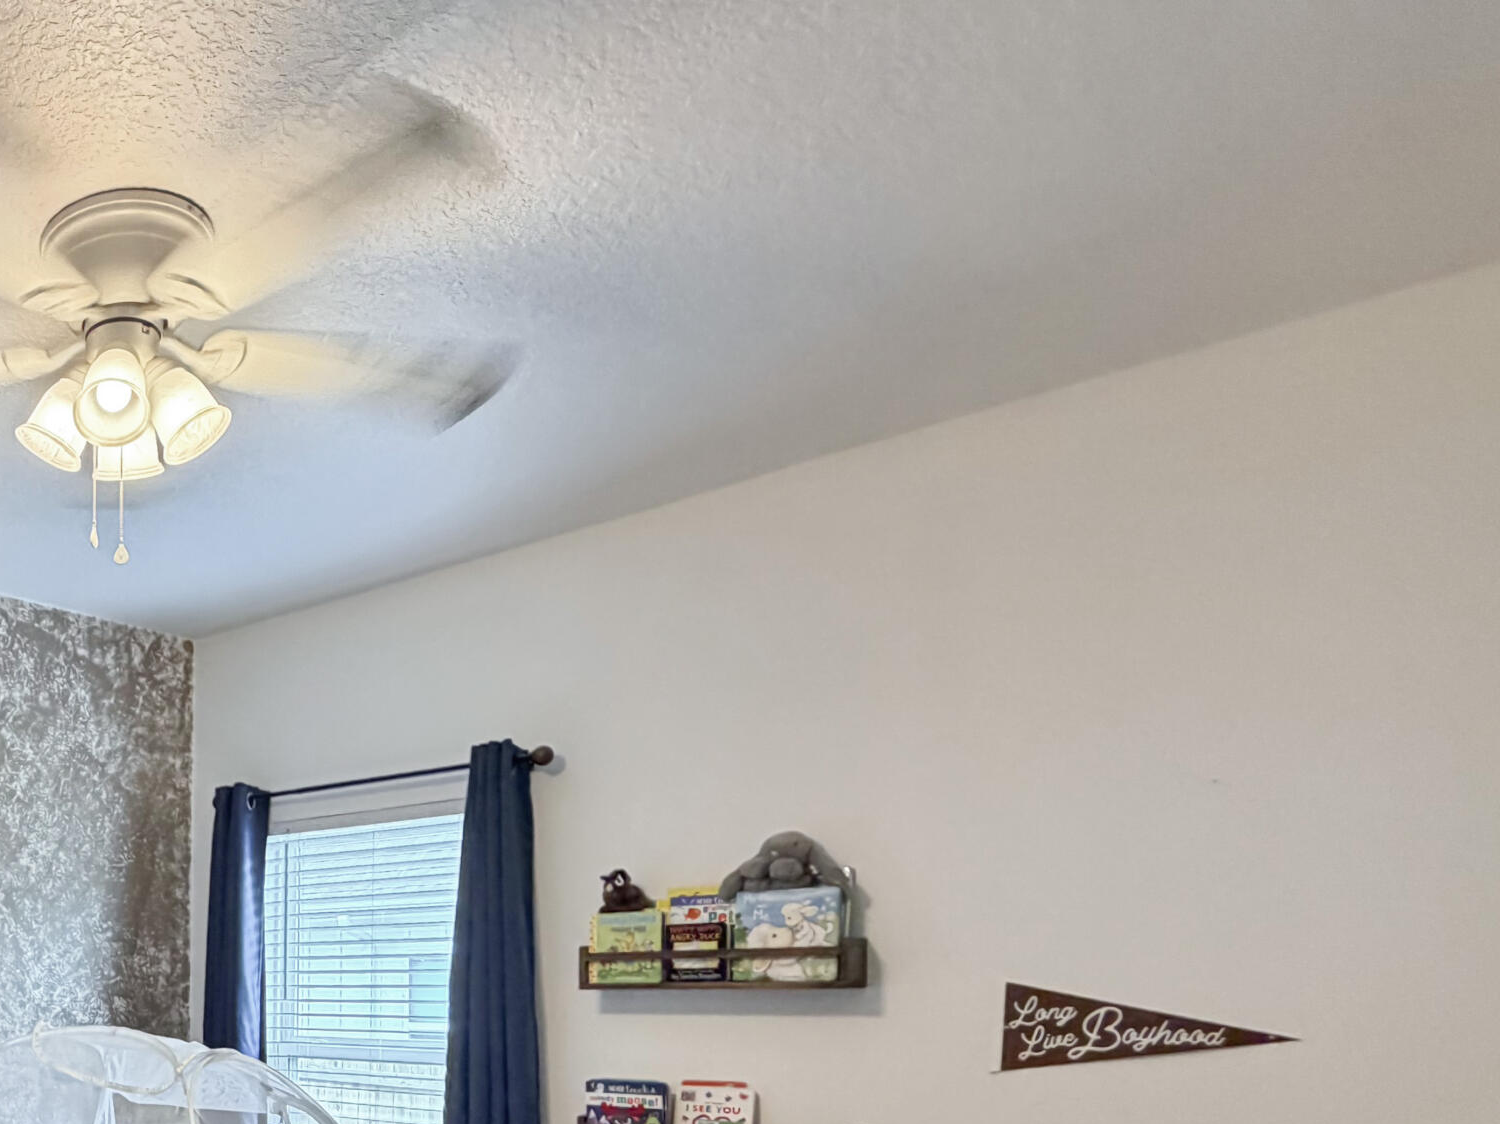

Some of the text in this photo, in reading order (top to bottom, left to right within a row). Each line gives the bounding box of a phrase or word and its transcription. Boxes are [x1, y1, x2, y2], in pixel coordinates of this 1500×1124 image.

[1009, 996, 1078, 1029] Long
[1018, 1006, 1226, 1061] Live Boyhood
[692, 1104, 712, 1113] SEE
[716, 1105, 741, 1115] YOU
